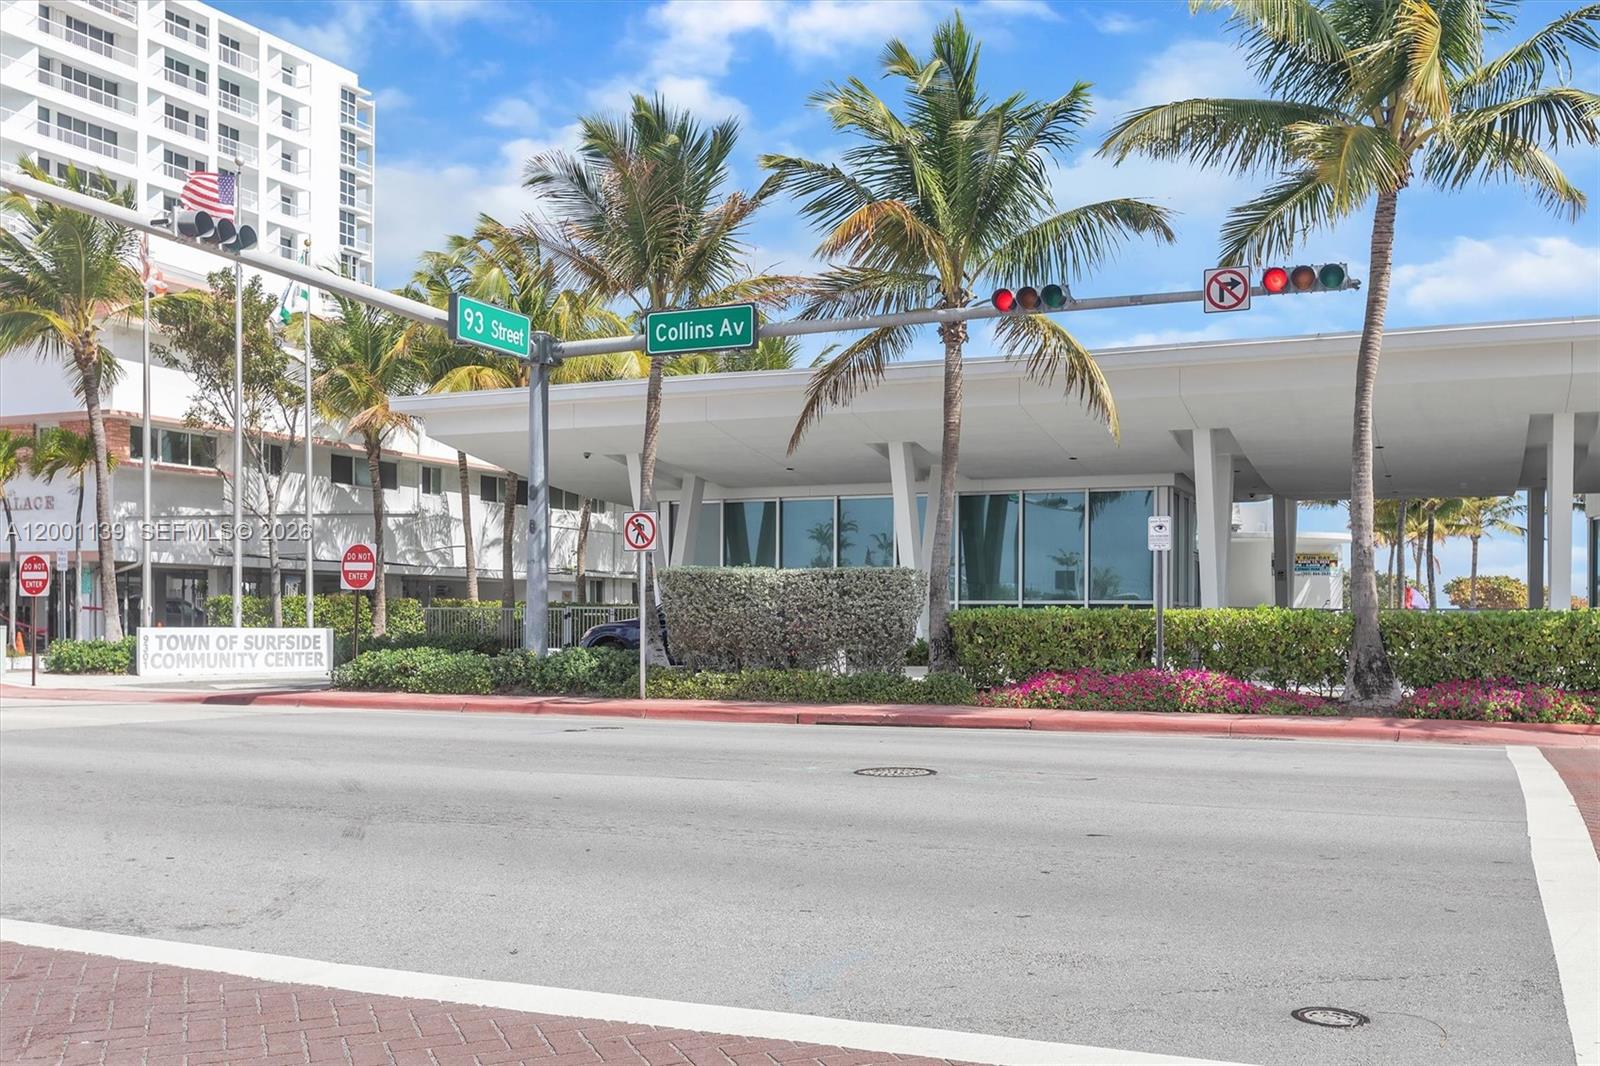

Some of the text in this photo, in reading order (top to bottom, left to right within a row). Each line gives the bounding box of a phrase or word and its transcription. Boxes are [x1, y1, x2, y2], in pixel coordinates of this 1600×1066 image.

[464, 308, 524, 347] 93 Street
[655, 318, 745, 342] Collins Av
[347, 552, 371, 560] DO NOT
[25, 580, 43, 588] ENTER
[348, 572, 368, 580] ENTER
[155, 634, 321, 651] TOWN OF SURFSIDE
[150, 651, 325, 669] COMMUNITY CENTER
